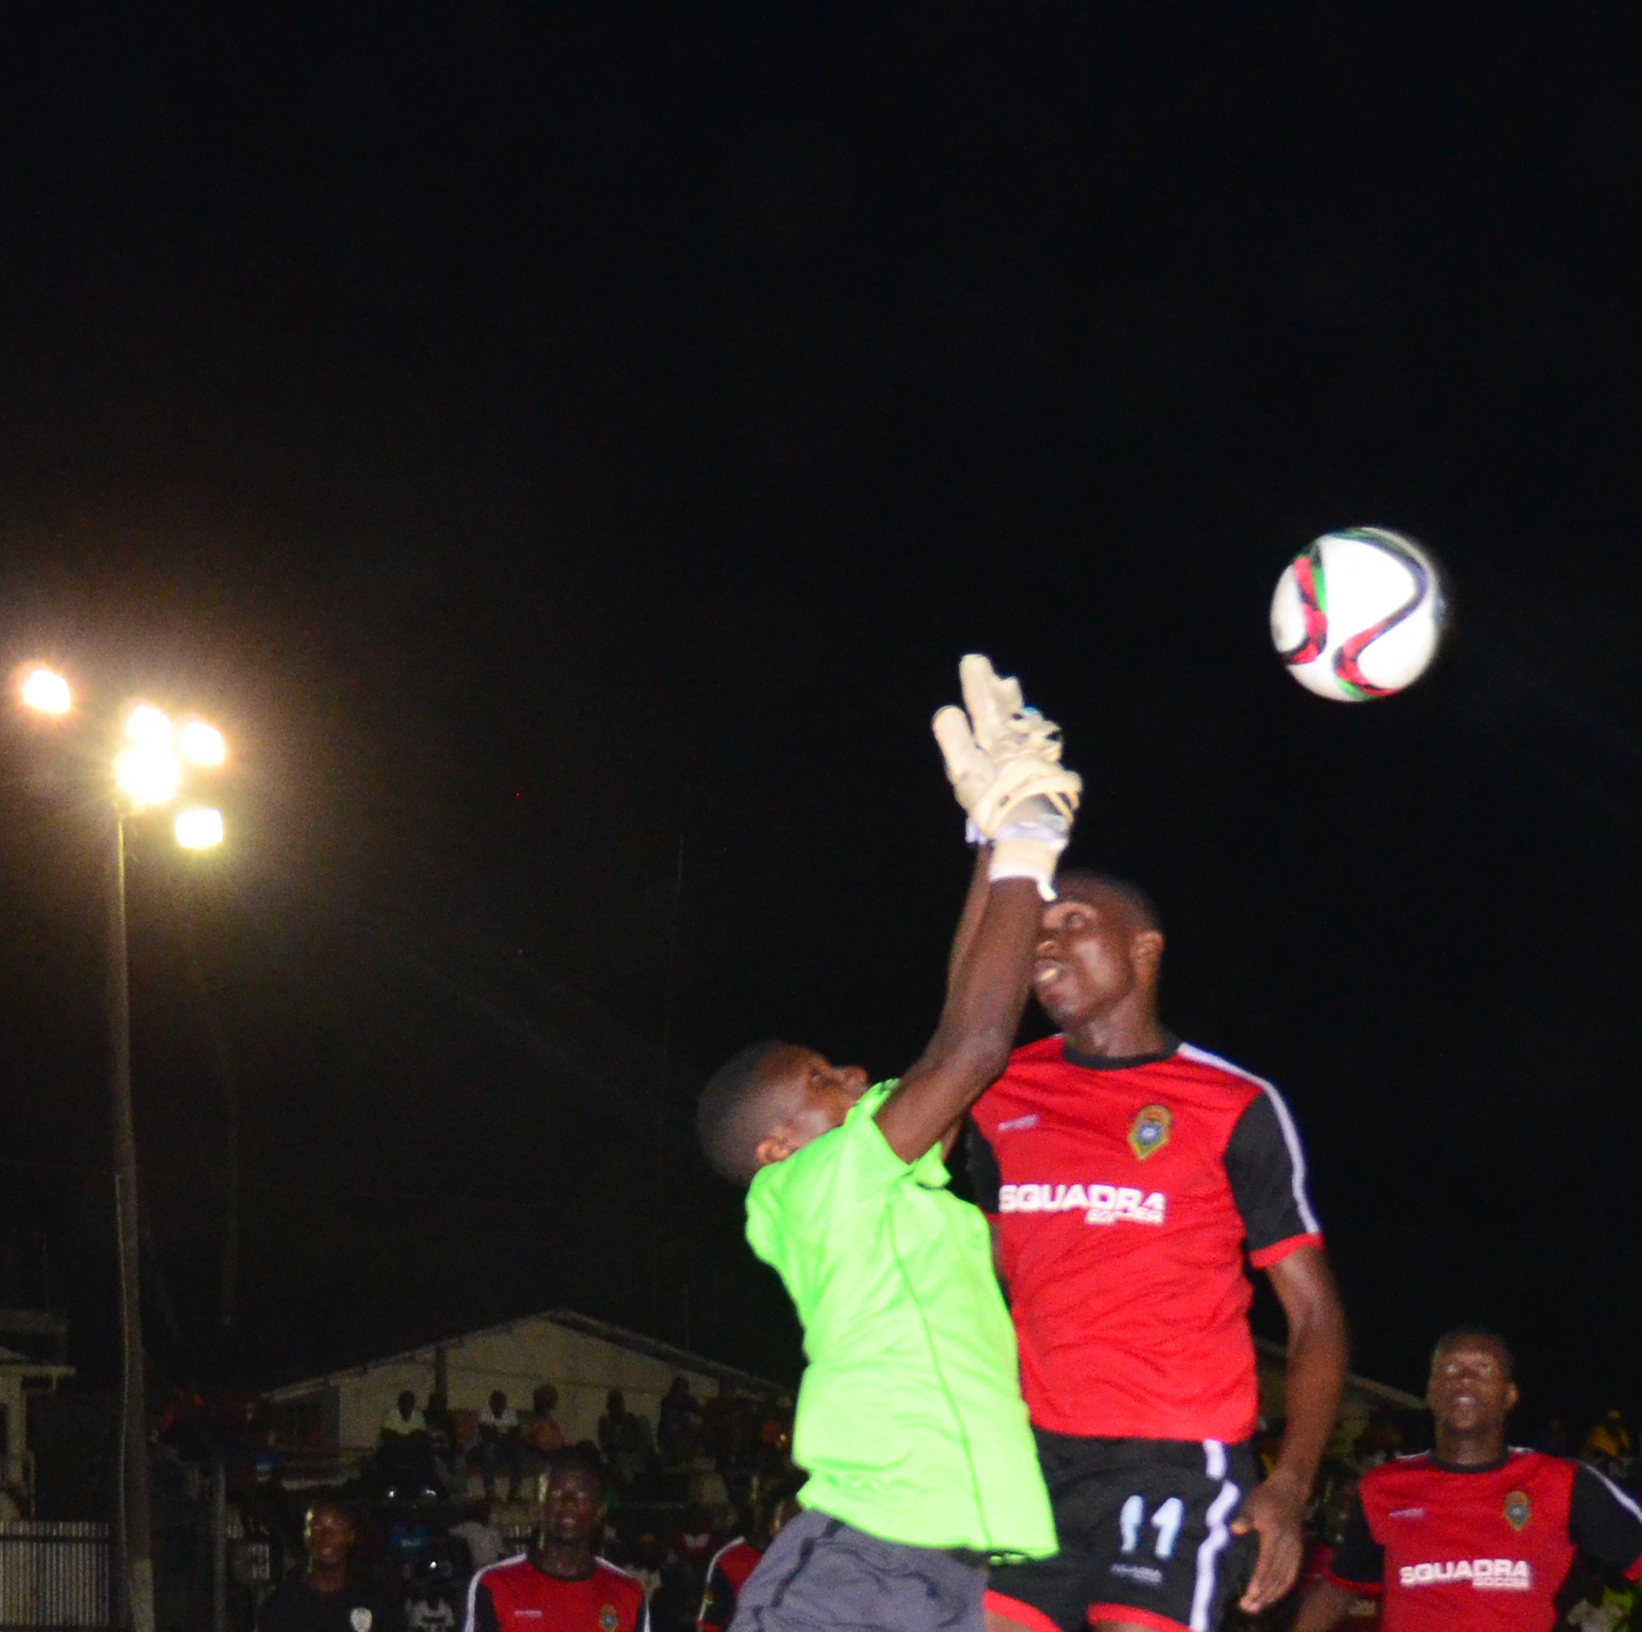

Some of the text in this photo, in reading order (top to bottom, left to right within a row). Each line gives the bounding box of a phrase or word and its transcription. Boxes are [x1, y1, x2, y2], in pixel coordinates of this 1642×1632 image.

[998, 1183, 1166, 1213] SQUADRA
[1120, 1495, 1185, 1558] 11
[1399, 1558, 1530, 1588] SQUADRA
